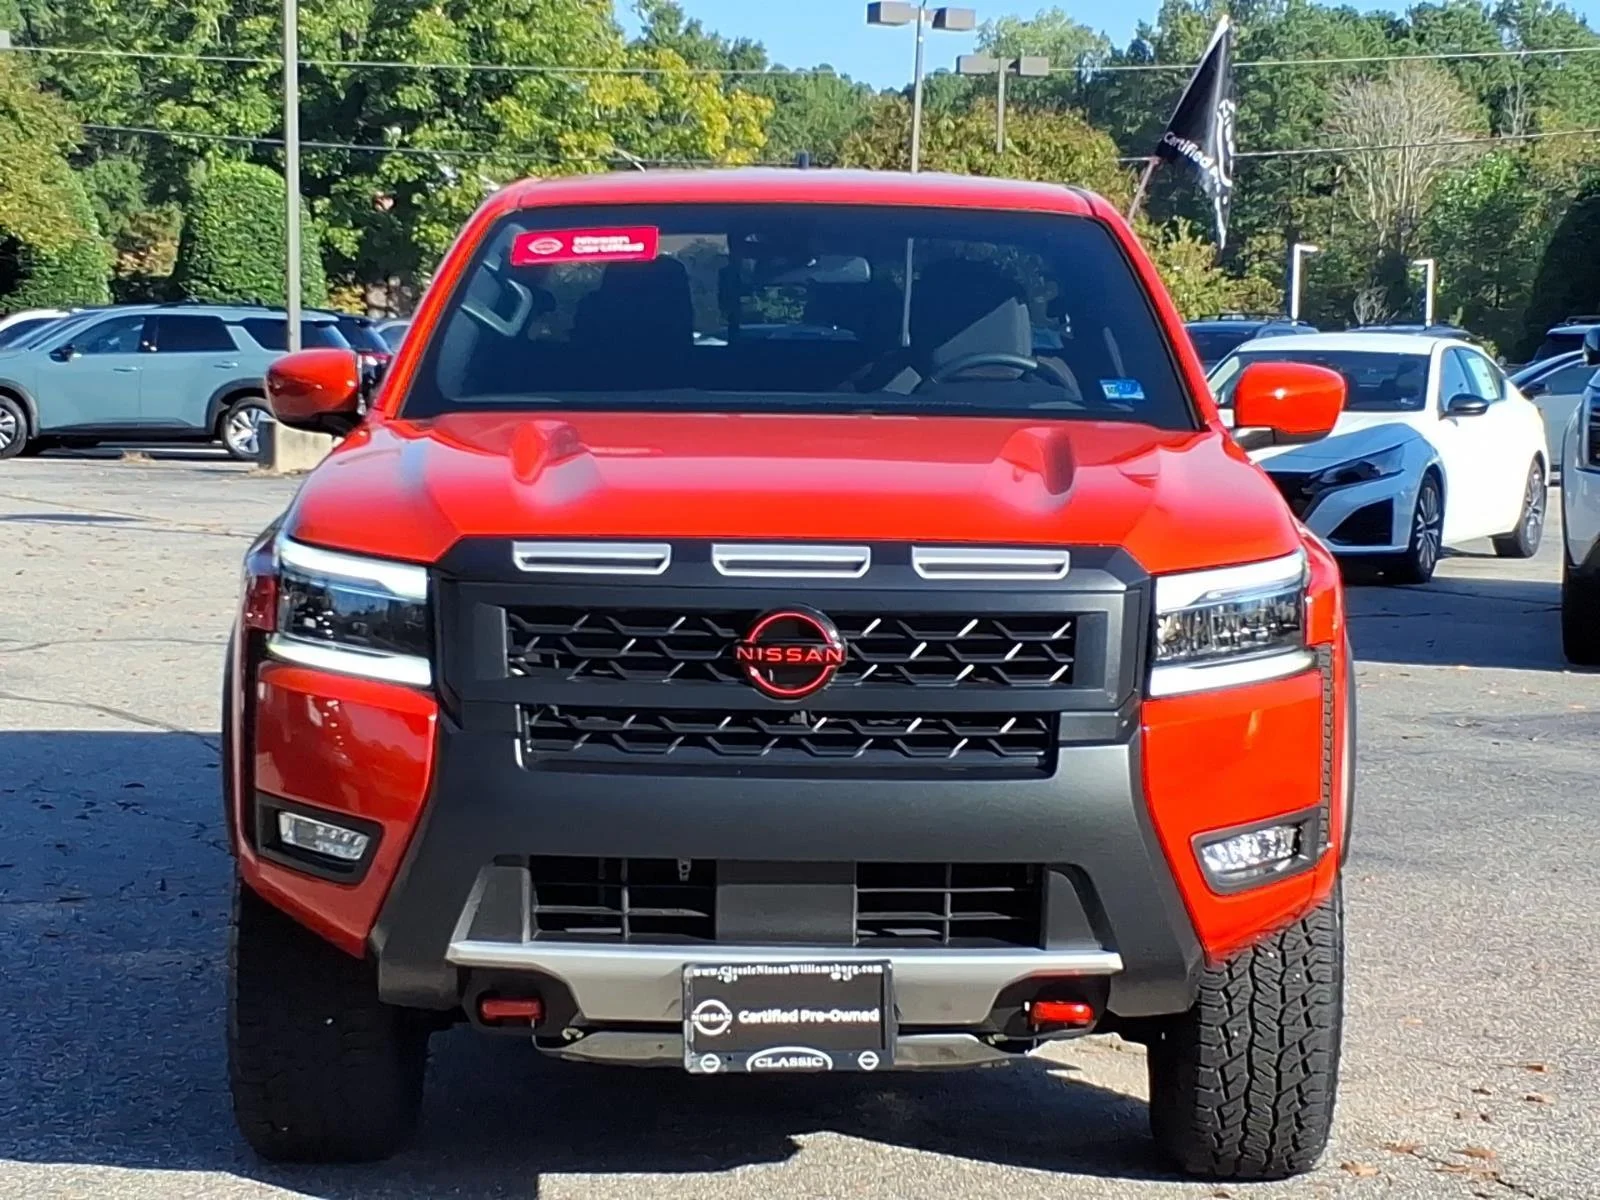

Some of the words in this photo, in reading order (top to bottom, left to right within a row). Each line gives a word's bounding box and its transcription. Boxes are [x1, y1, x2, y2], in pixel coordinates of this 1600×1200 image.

[1164, 132, 1214, 169] Certified
[736, 646, 842, 662] NISSAN
[739, 1008, 798, 1024] Certified
[800, 1008, 880, 1023] Pre-Owned
[754, 1056, 824, 1068] CLASSIC
